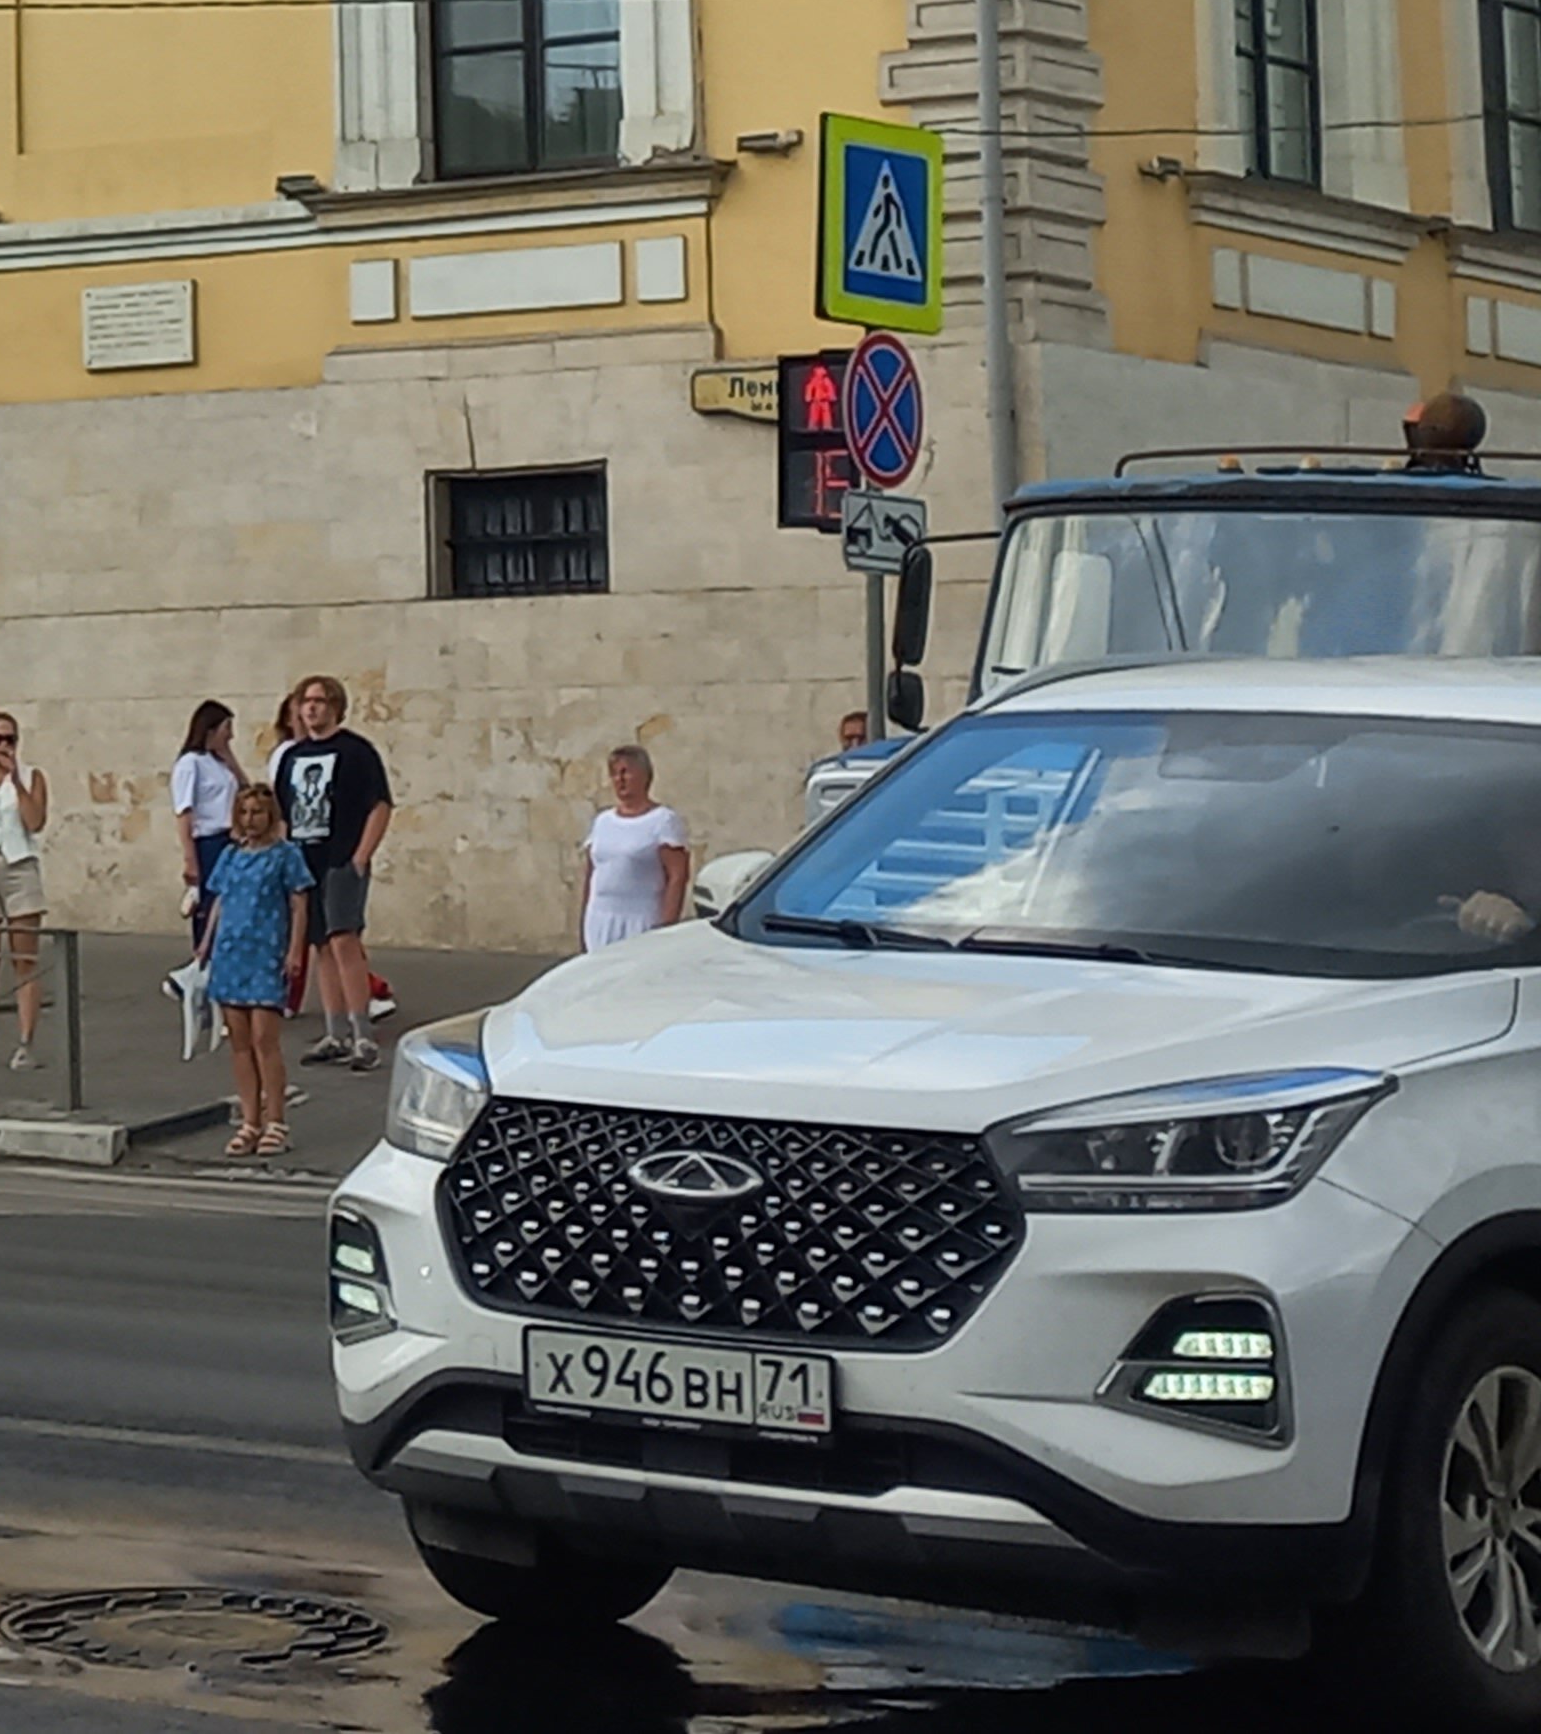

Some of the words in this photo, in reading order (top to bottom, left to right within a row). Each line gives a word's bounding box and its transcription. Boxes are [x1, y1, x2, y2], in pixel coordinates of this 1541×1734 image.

[546, 1343, 744, 1415] Х946ВН
[759, 1358, 810, 1407] 71
[757, 1402, 797, 1421] RUS
